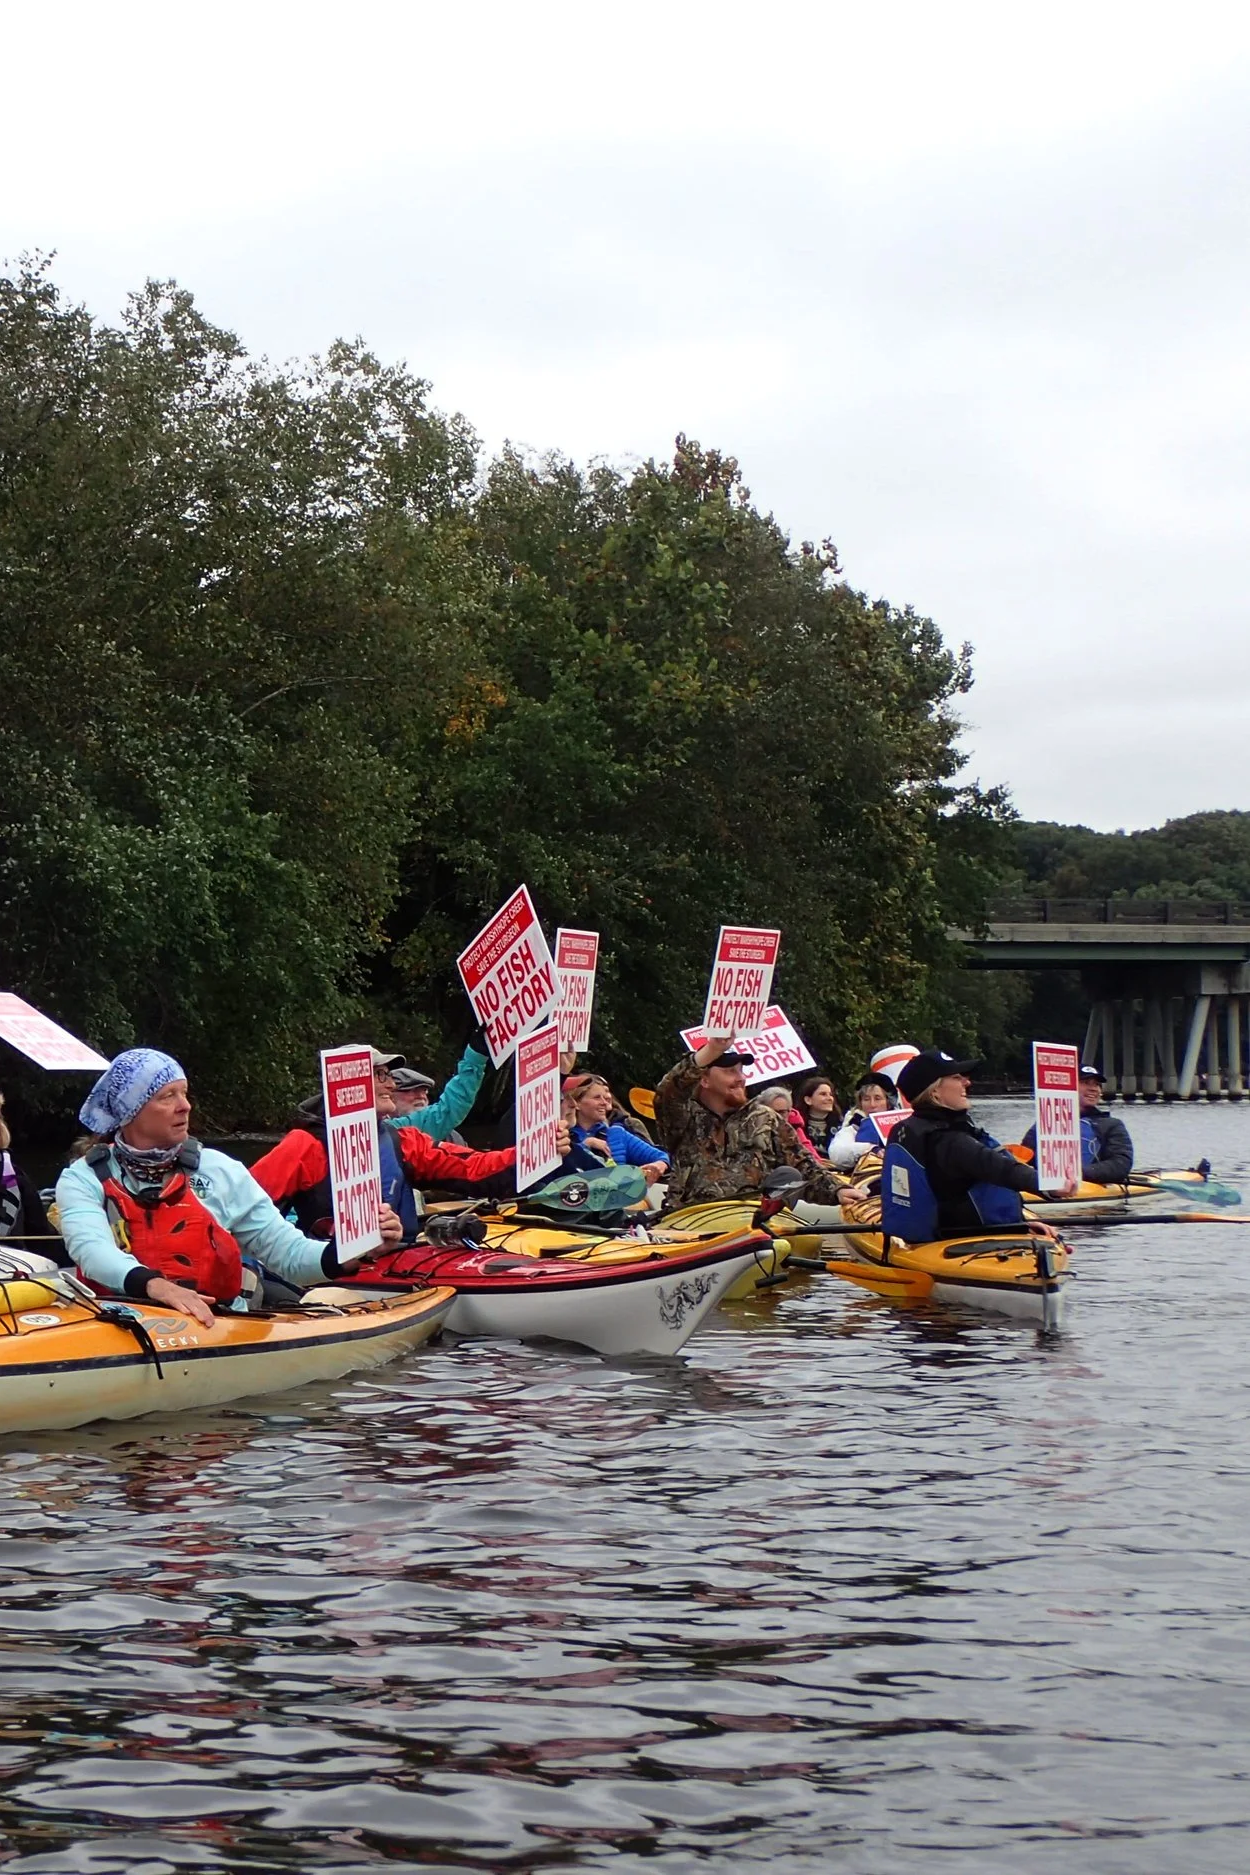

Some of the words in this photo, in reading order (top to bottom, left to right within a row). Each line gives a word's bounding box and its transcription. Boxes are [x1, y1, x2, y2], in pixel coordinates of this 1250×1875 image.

[474, 980, 500, 1024] NO
[496, 939, 537, 1000] FISH
[568, 975, 588, 1007] FISH
[713, 967, 733, 997] NO
[734, 968, 764, 998] FISH
[486, 961, 555, 1058] FACTORY
[707, 1000, 765, 1029] FACTORY
[734, 1032, 785, 1055] FISH
[520, 1090, 533, 1134] NO
[535, 1078, 554, 1126] FISH
[1038, 1097, 1052, 1135] NO
[1054, 1098, 1074, 1135] FISH
[332, 1126, 350, 1183] NO
[350, 1120, 374, 1178] FISH
[520, 1119, 560, 1178] FACTORY
[1040, 1140, 1079, 1179] FACTORY
[337, 1177, 381, 1245] FACTORY
[156, 1335, 199, 1348] ECKY
